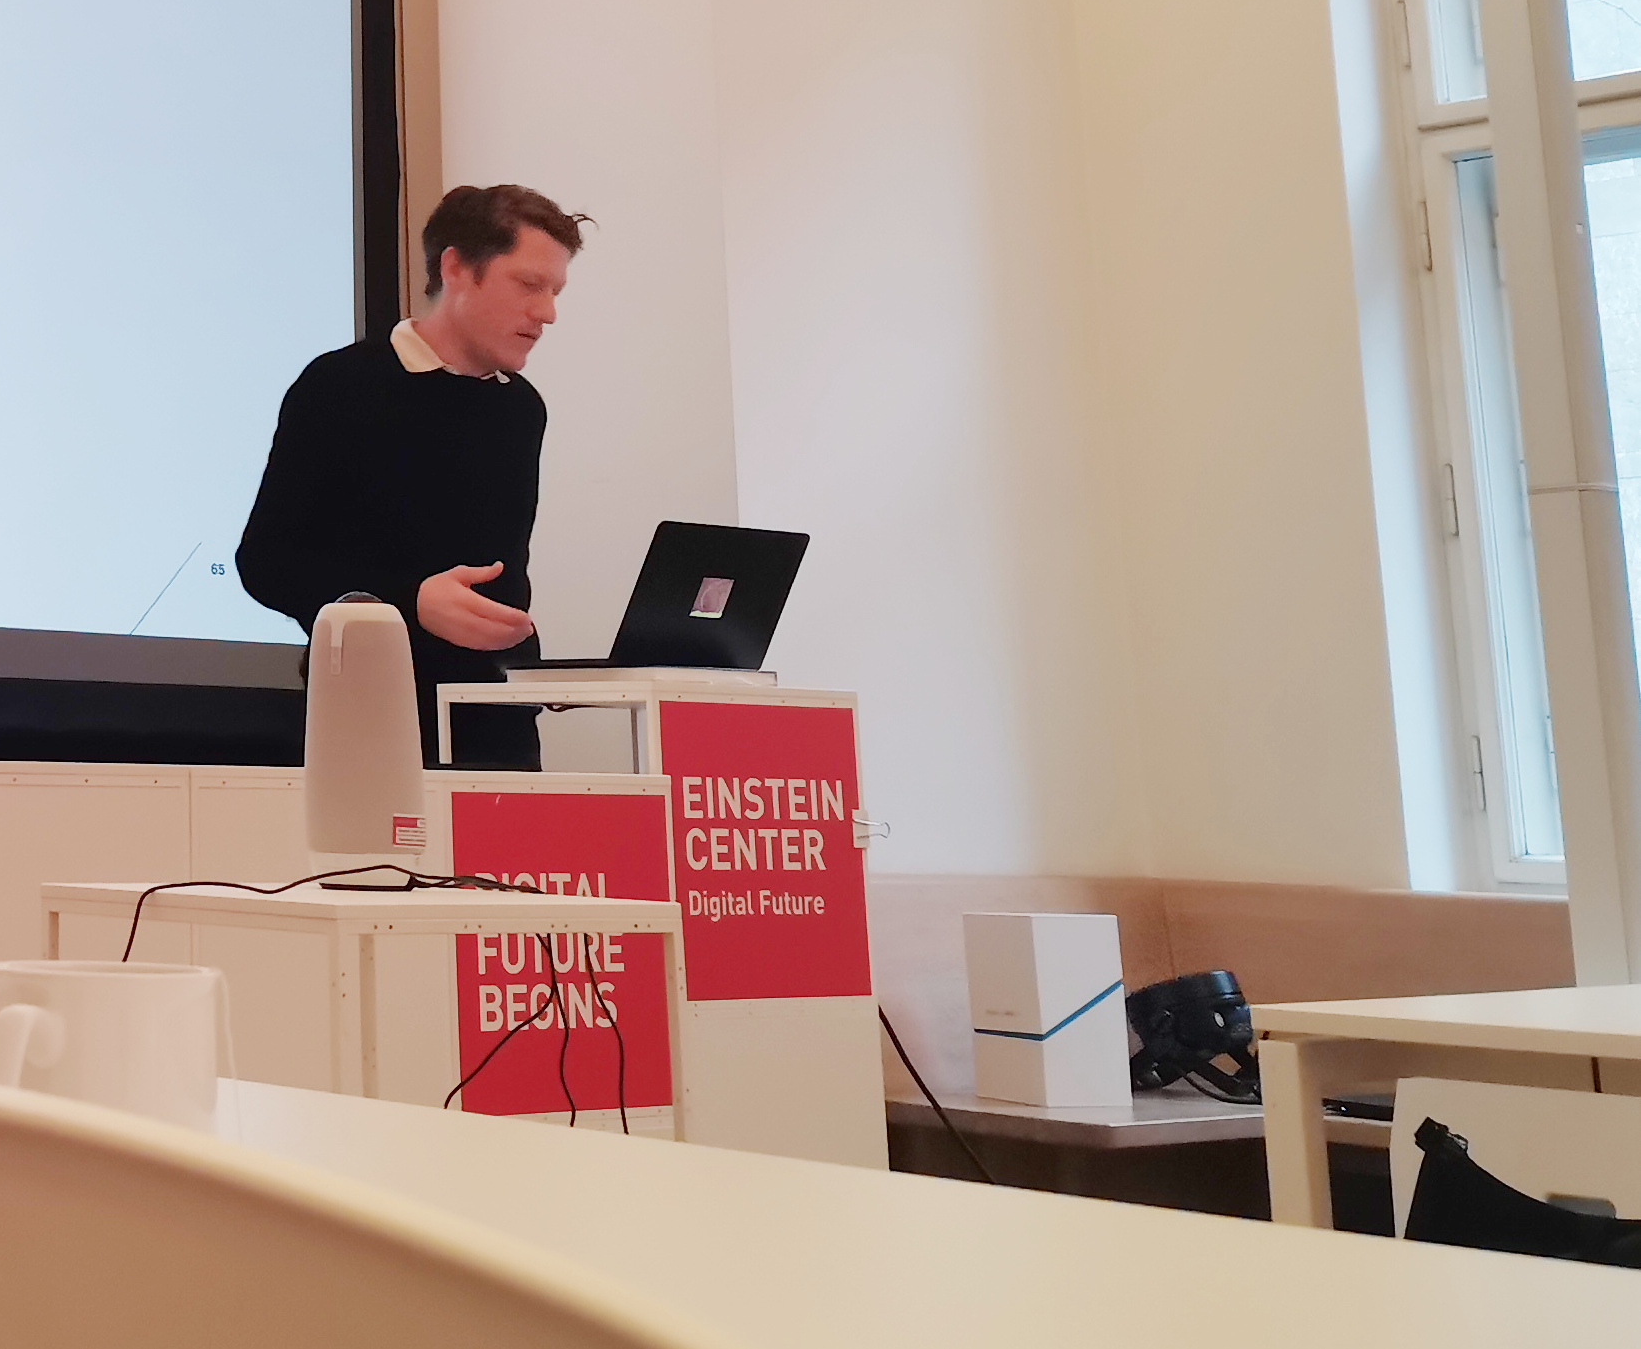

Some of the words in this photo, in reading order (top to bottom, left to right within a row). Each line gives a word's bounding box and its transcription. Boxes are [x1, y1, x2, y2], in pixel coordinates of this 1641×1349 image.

[210, 562, 226, 576] 65
[682, 776, 845, 821] EINSTEIN
[685, 827, 827, 871] CENTER
[688, 889, 755, 922] Digital
[759, 889, 826, 915] Future
[477, 933, 625, 975] FUTURE
[478, 981, 619, 1032] BEGINS
